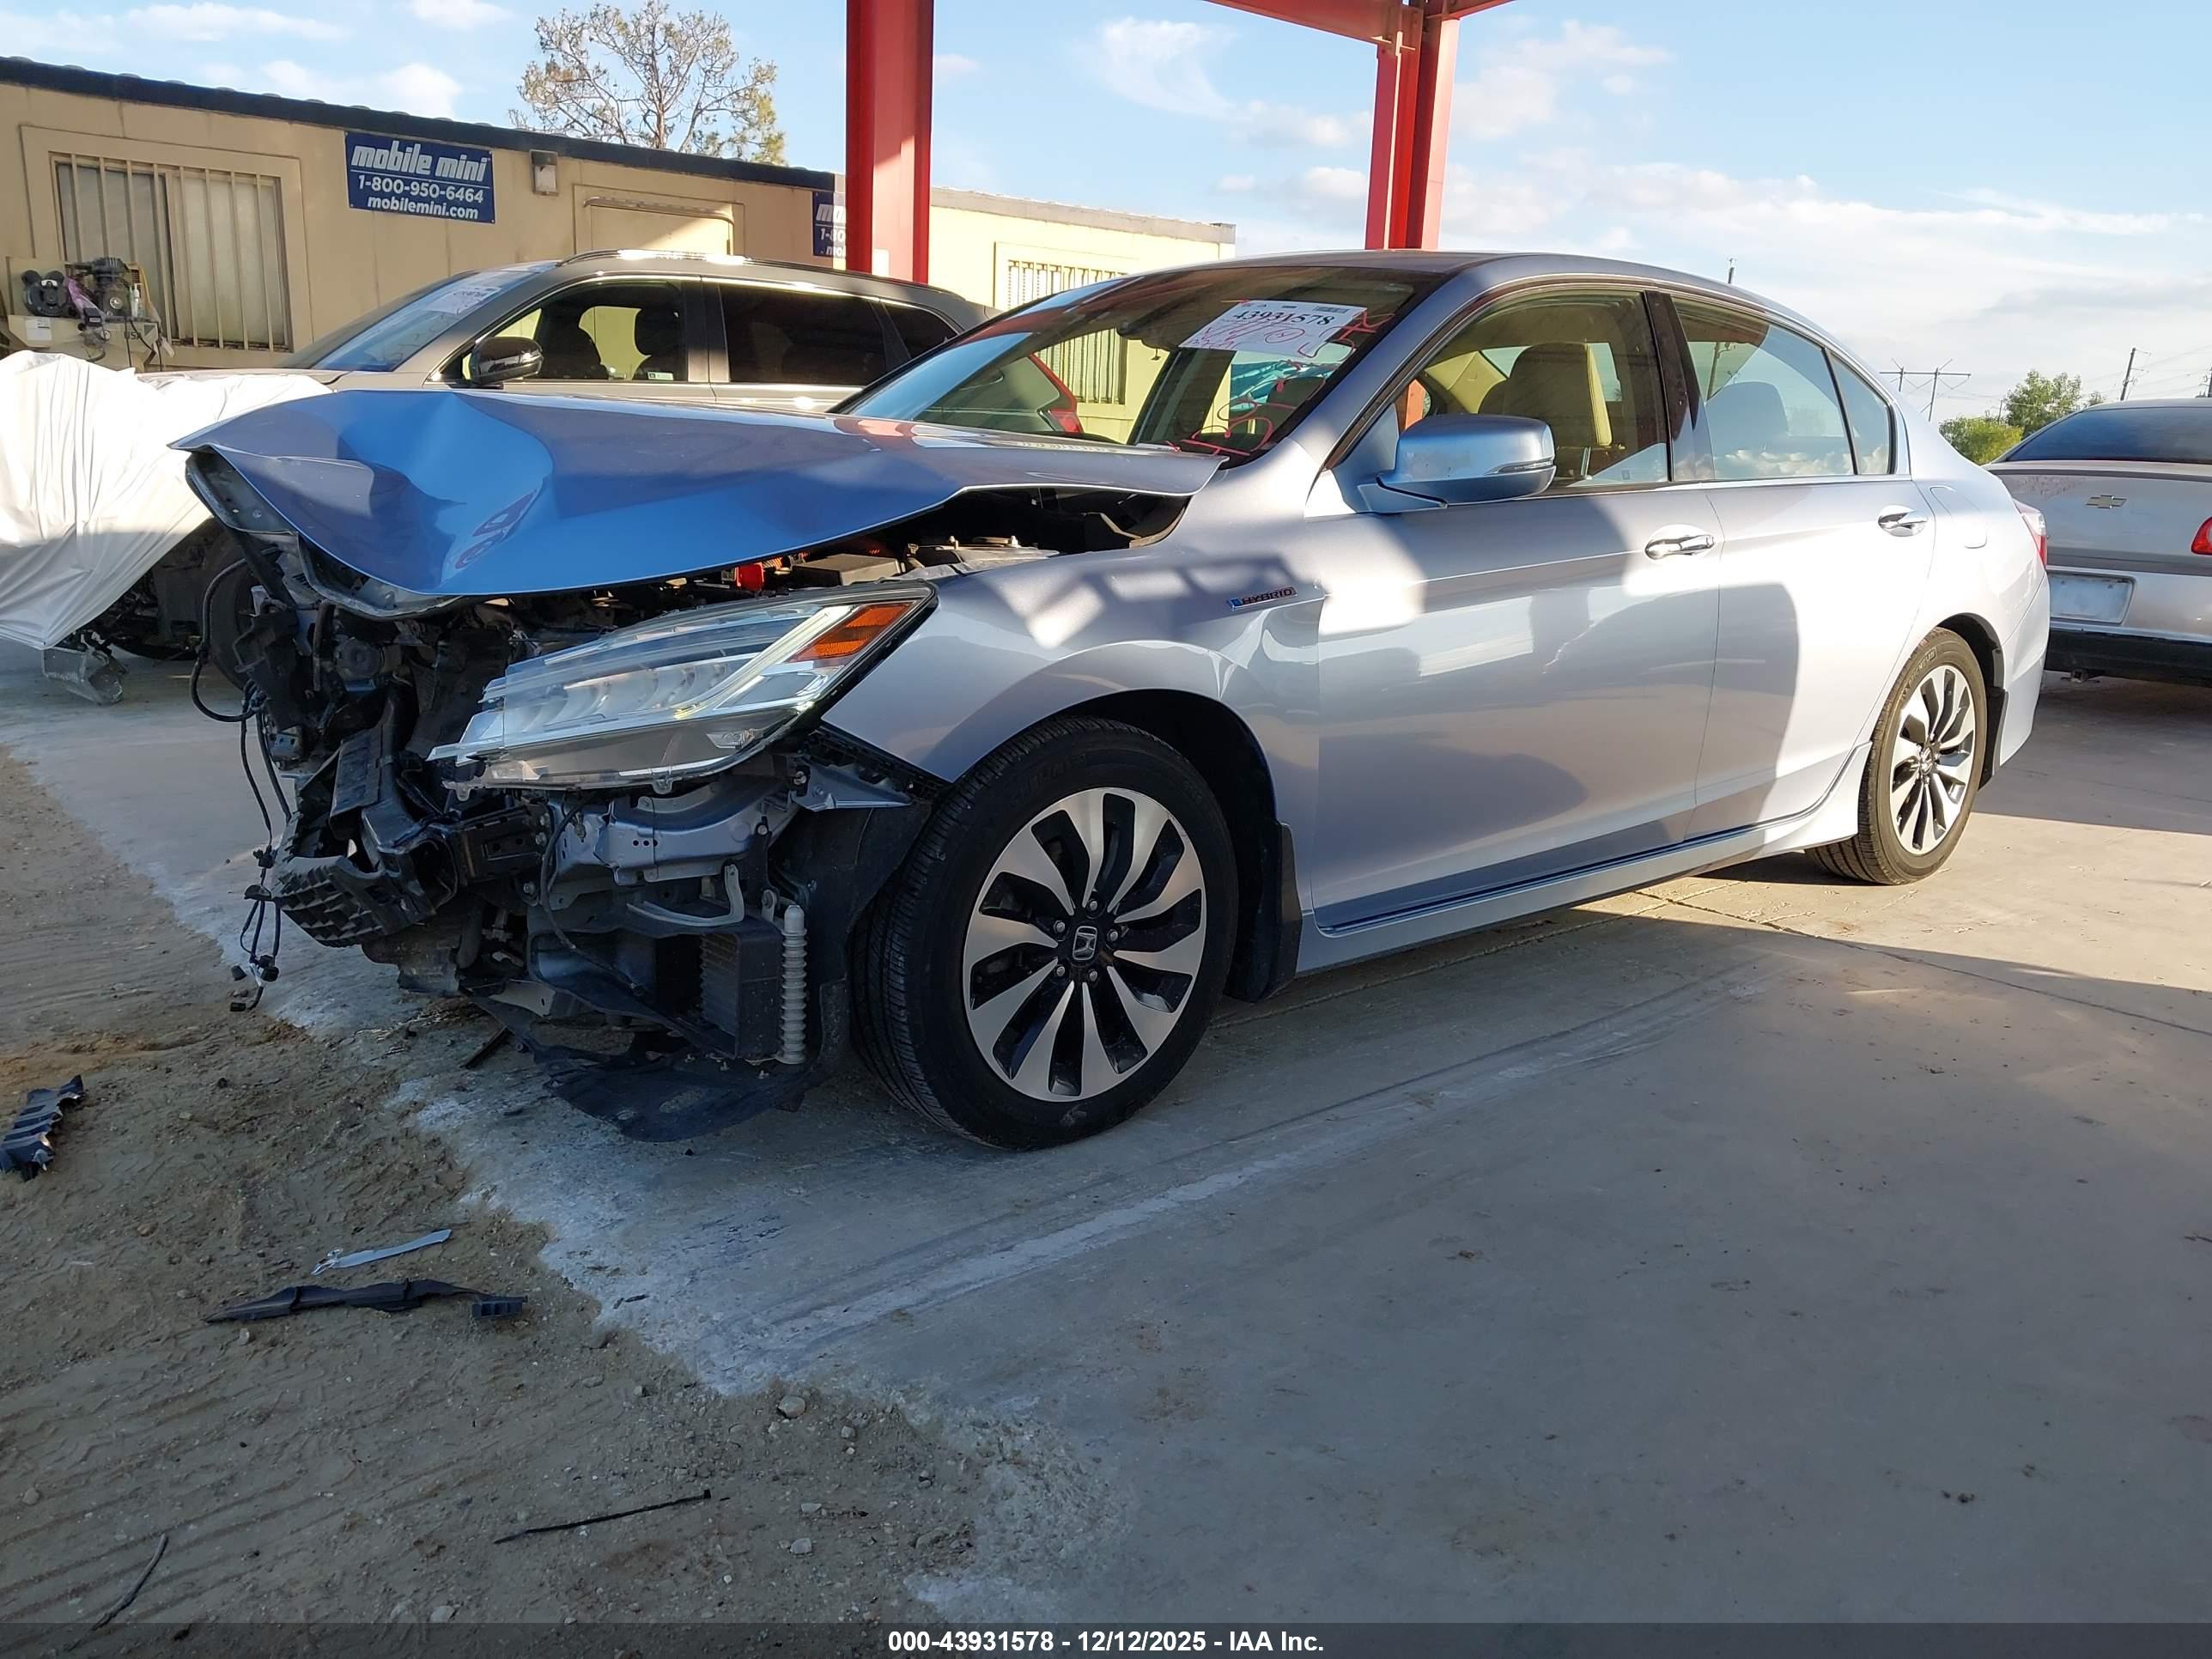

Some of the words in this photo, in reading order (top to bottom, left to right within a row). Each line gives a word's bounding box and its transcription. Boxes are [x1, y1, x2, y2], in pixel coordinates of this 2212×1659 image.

[350, 140, 433, 175] mobile
[434, 154, 488, 182] mini
[358, 174, 483, 204] 1-800-950-6464
[368, 196, 478, 220] mobilemini.com
[1233, 311, 1335, 325] 43931578
[1241, 587, 1292, 605] HYBRID
